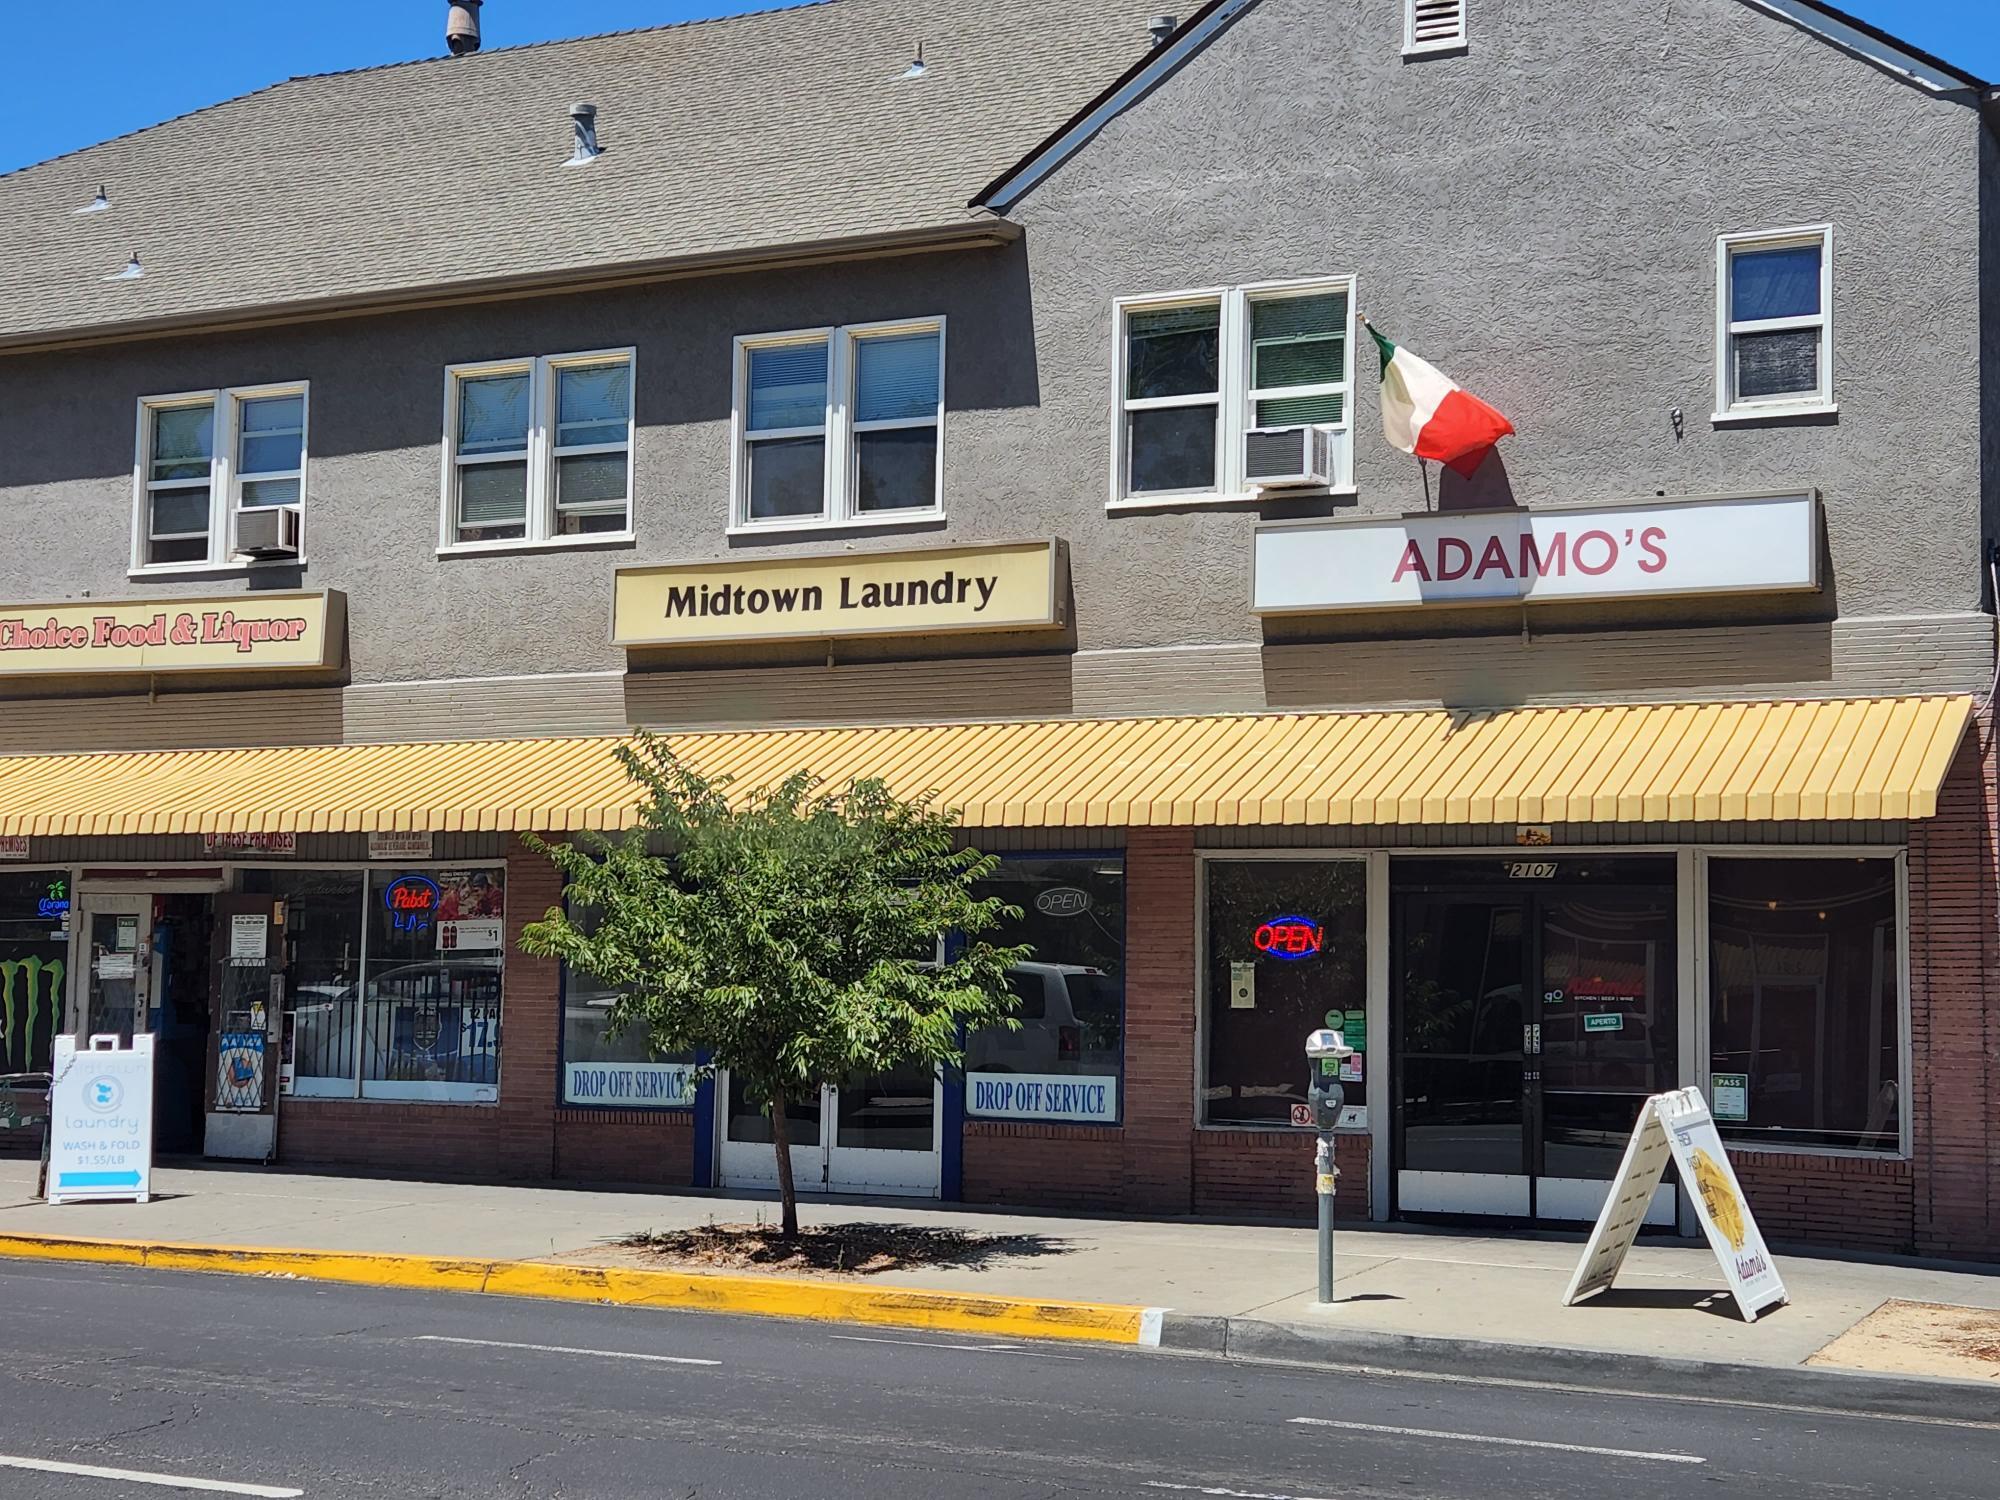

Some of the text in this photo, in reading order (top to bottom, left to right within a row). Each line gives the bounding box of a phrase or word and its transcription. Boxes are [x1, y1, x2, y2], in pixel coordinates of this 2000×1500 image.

[1391, 526, 1668, 583] ADAMO'S
[664, 571, 998, 618] Midtown Laundry
[0, 610, 307, 652] Choice Food & Liquor
[0, 835, 27, 852] REMISES
[1511, 864, 1557, 877] 2107
[39, 898, 69, 911] Corona
[393, 887, 432, 909] Pabst
[1037, 893, 1087, 910] OPEN
[488, 929, 498, 942] $1
[1254, 924, 1324, 952] OPEN
[1591, 1018, 1617, 1026] APERTO
[573, 1070, 606, 1097] DROP
[608, 1070, 633, 1097] OFF
[1718, 1079, 1741, 1087] PASS
[975, 1081, 1105, 1114] DROP OFF SERVICE
[63, 1139, 140, 1151] WASH & FOLD
[77, 1154, 125, 1166] $1.55/LB
